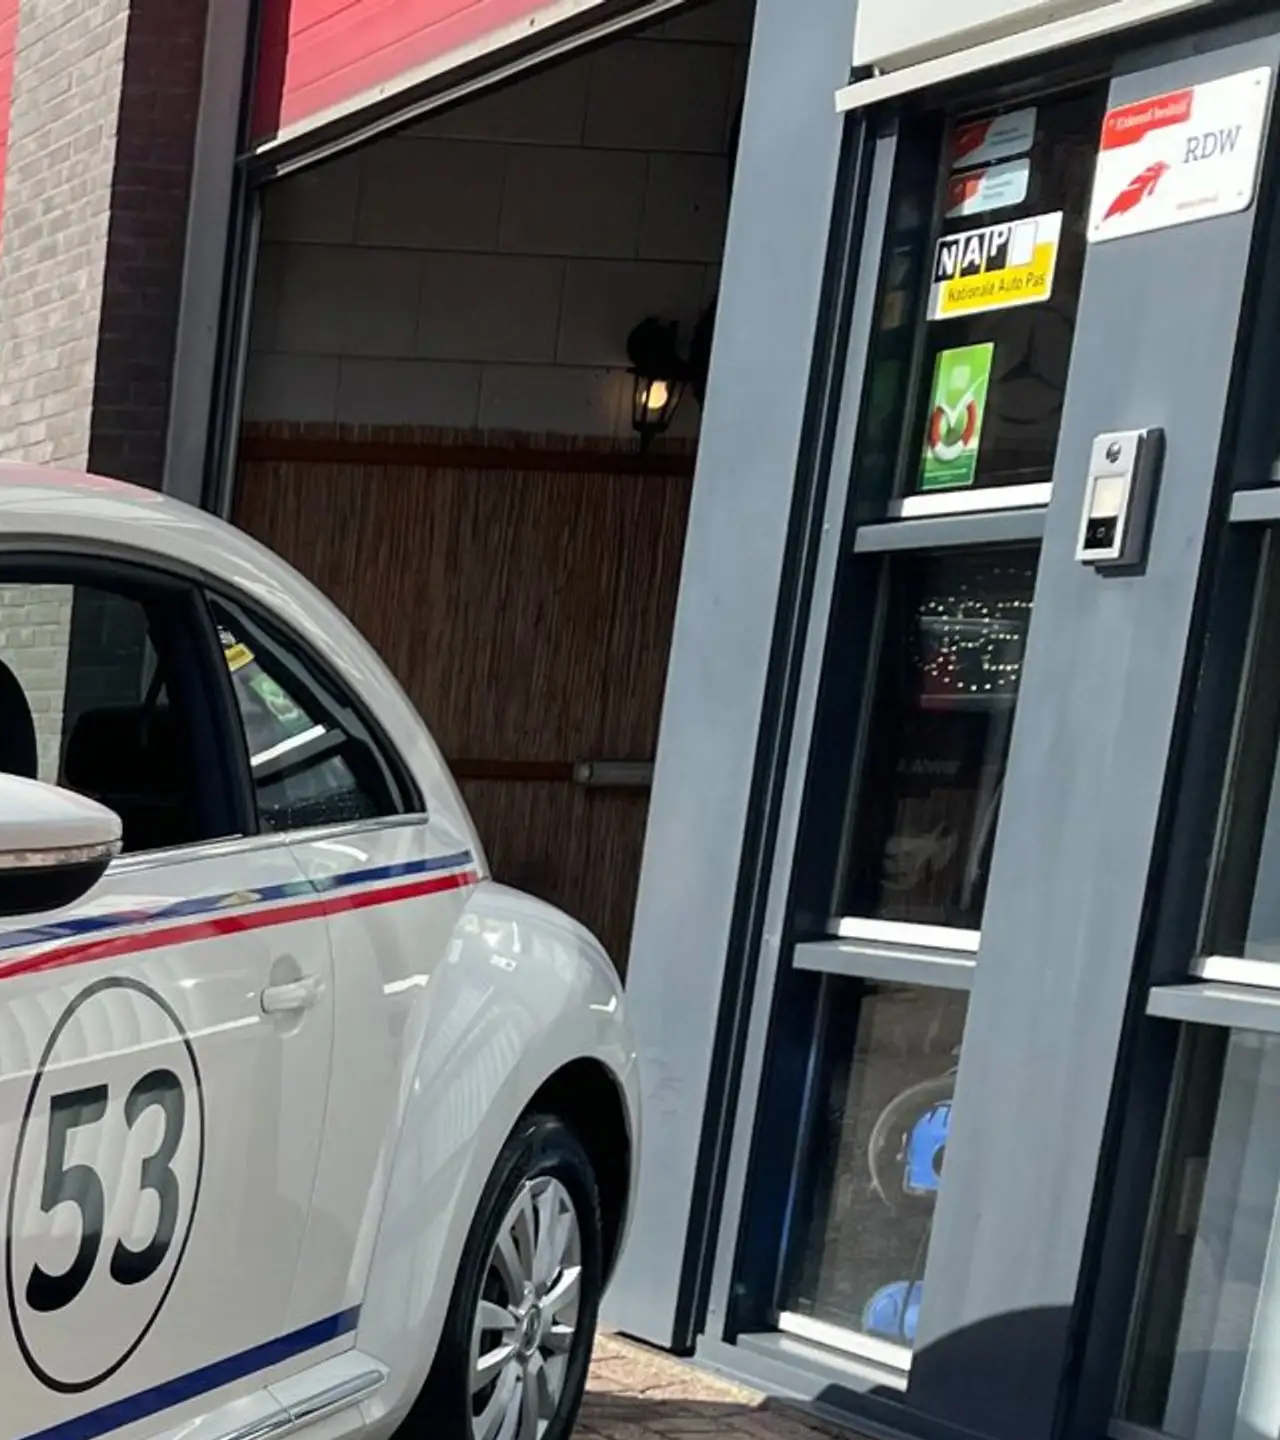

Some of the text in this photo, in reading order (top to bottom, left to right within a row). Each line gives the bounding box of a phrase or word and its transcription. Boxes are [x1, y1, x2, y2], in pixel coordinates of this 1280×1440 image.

[1182, 125, 1242, 164] RDW
[936, 225, 1011, 280] NAP
[25, 1068, 186, 1313] 53
